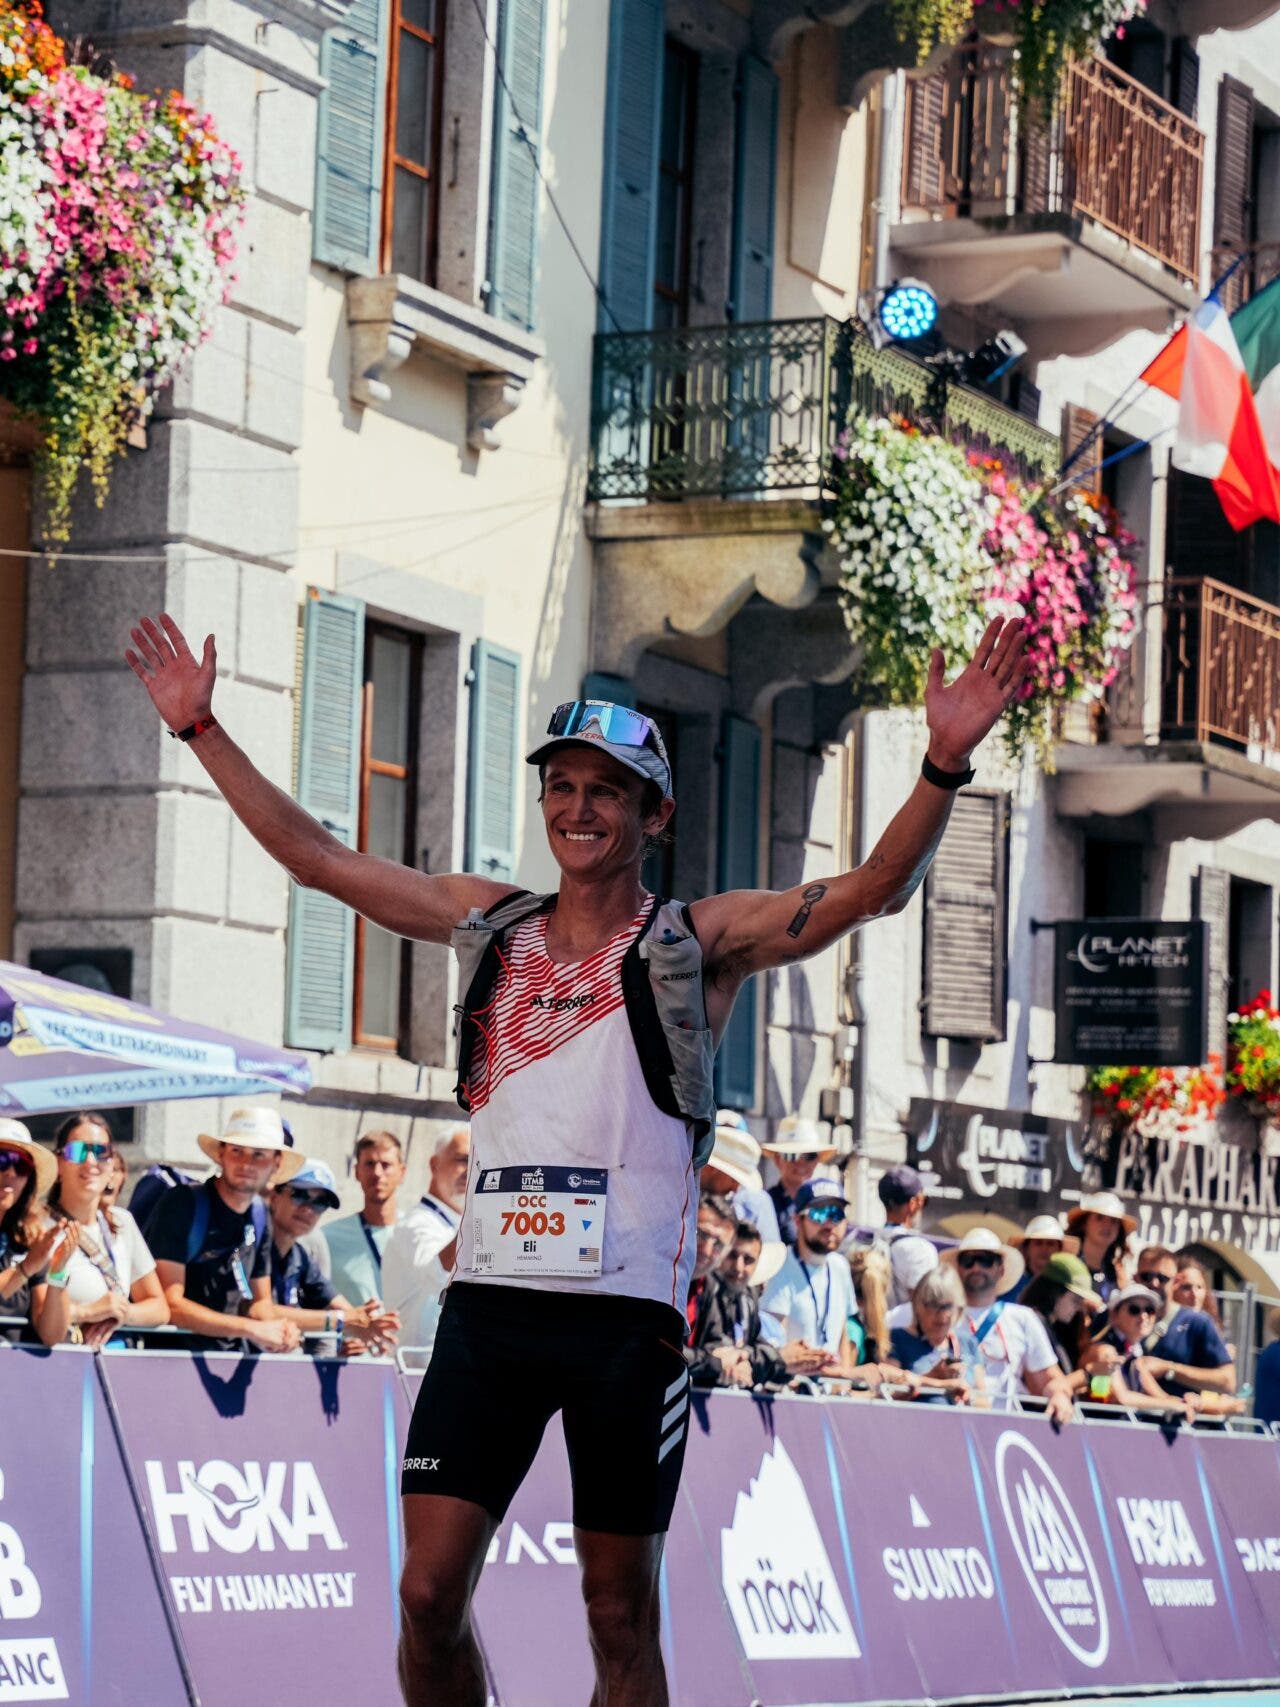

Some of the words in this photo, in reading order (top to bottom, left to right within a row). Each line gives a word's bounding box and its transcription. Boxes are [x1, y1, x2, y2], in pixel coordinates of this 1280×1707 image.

[518, 1195, 547, 1208] OCC
[500, 1211, 566, 1236] 7003
[523, 1240, 537, 1252] Eli
[145, 1459, 344, 1553] HOKA
[170, 1575, 214, 1613] FLY
[217, 1573, 316, 1611] HUMAN
[316, 1573, 355, 1609] FLY
[883, 1546, 995, 1601] SUUNTO
[740, 1558, 842, 1634] näak
